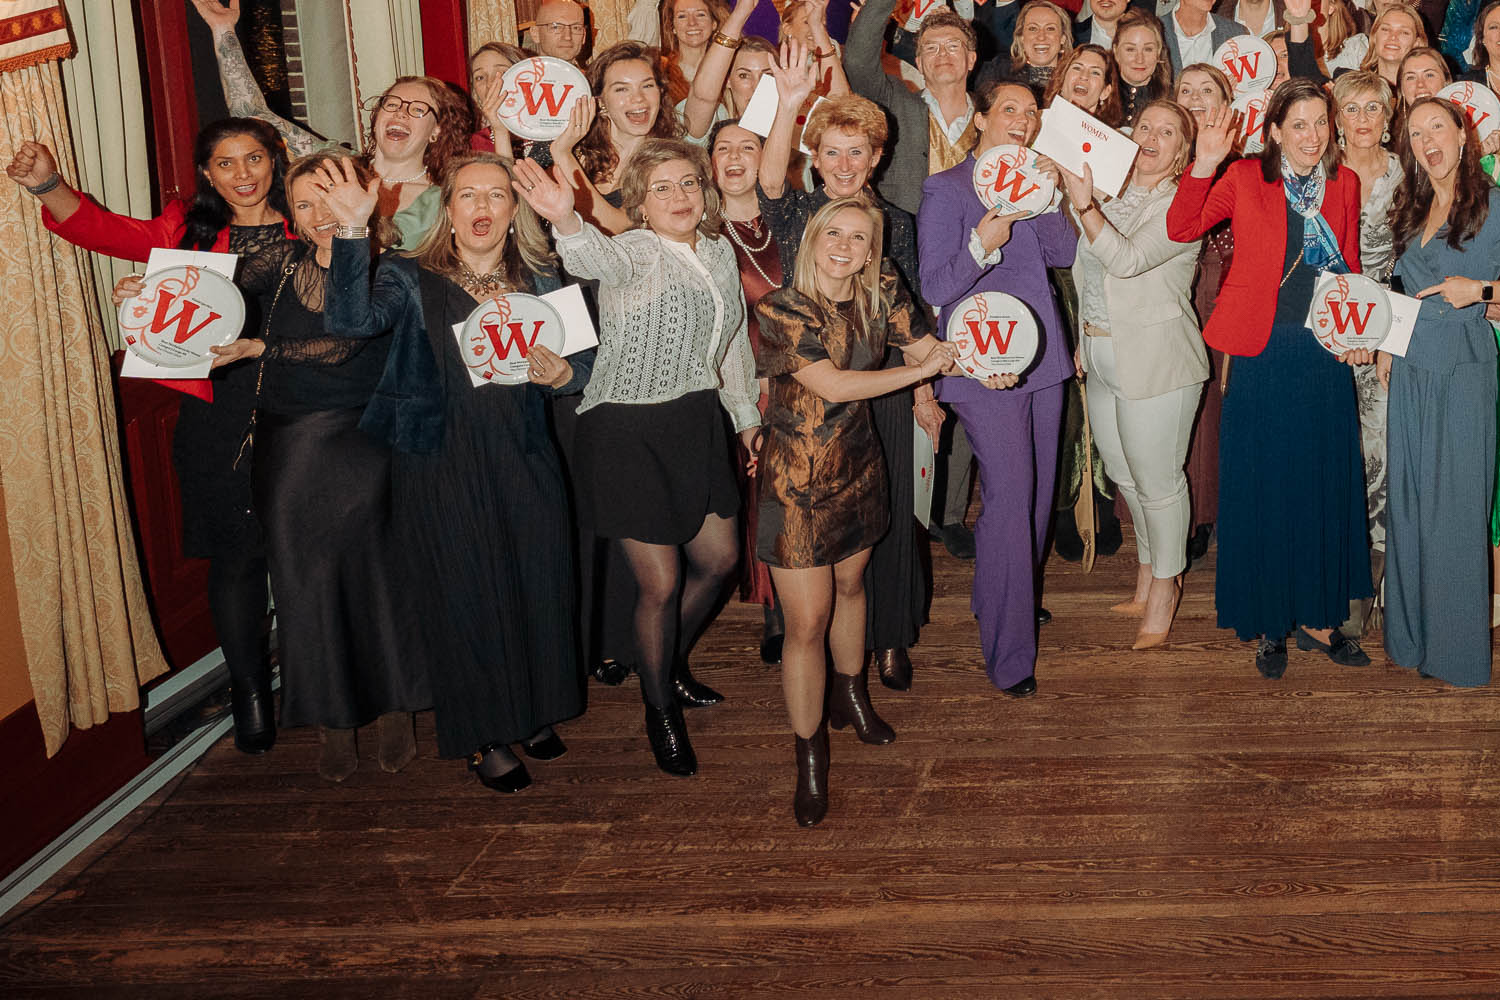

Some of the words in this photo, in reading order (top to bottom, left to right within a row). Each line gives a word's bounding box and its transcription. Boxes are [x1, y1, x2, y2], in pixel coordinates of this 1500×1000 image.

[1224, 51, 1261, 83] W
[518, 82, 575, 117] W
[1080, 120, 1110, 142] WOMEN
[994, 160, 1041, 203] W
[148, 289, 222, 344] W
[1328, 301, 1377, 335] W
[482, 318, 548, 362] W
[966, 320, 1018, 355] W
